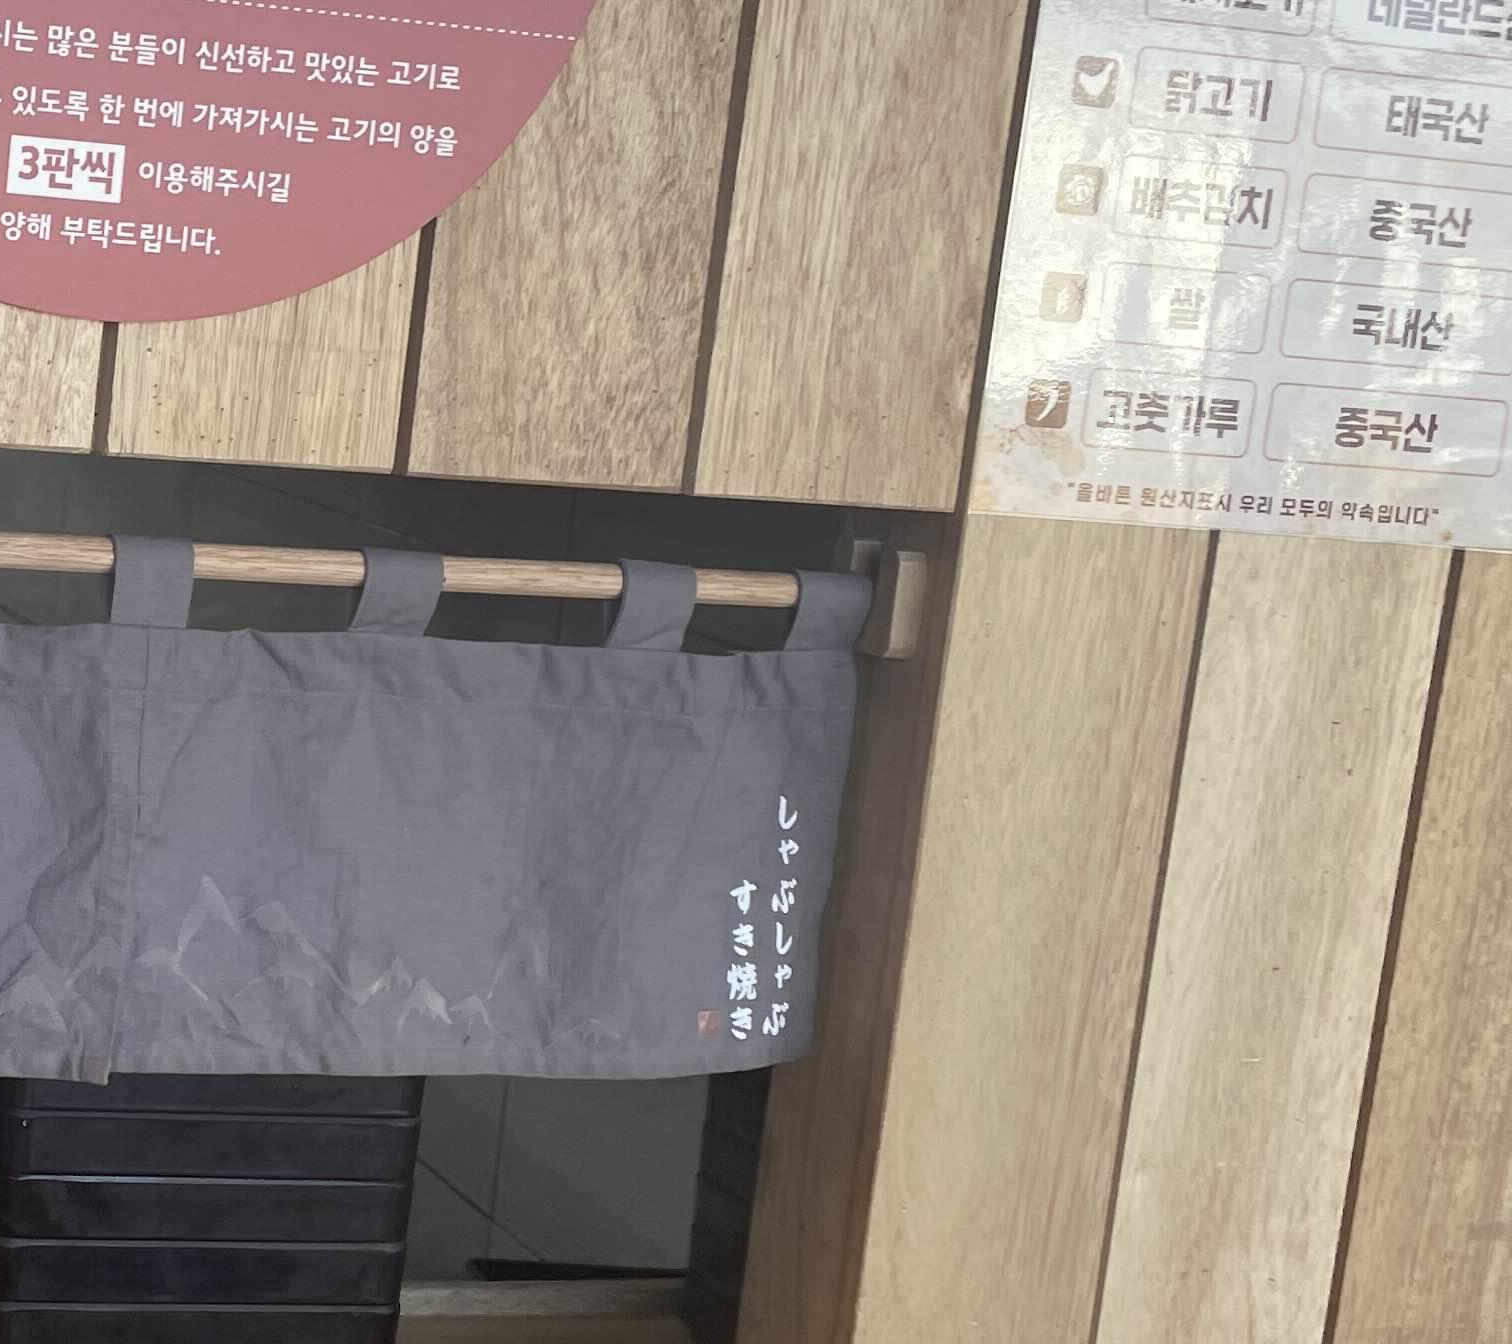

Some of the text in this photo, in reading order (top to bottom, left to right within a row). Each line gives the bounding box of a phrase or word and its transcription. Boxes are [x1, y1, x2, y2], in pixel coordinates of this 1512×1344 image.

[47, 23, 99, 59] 많은
[108, 31, 186, 66] 분들이
[195, 39, 296, 75] 신선하고
[304, 50, 379, 86] 맛있는
[389, 58, 461, 91] 고기로
[12, 85, 89, 122] 있도록
[99, 93, 125, 126] 한
[133, 97, 183, 129] 번에
[192, 103, 318, 145] 가져가시는
[327, 115, 401, 149] 고기의
[409, 122, 458, 157] 양을
[1165, 69, 1274, 122] 닭고기
[1385, 95, 1489, 145] 태국산
[17, 143, 116, 196] 3판씩
[138, 161, 291, 202] 이용해주시길
[0, 211, 222, 256] 양해 부탁드립니다.
[1368, 198, 1473, 249] 중국산
[1352, 302, 1455, 353] 국내산
[1334, 406, 1438, 454] 중국산
[1239, 494, 1273, 515] 우리
[1279, 498, 1333, 520] 모두의
[763, 795, 799, 1036] しゃぶしゃぶ
[727, 880, 759, 1040] すき焼き
